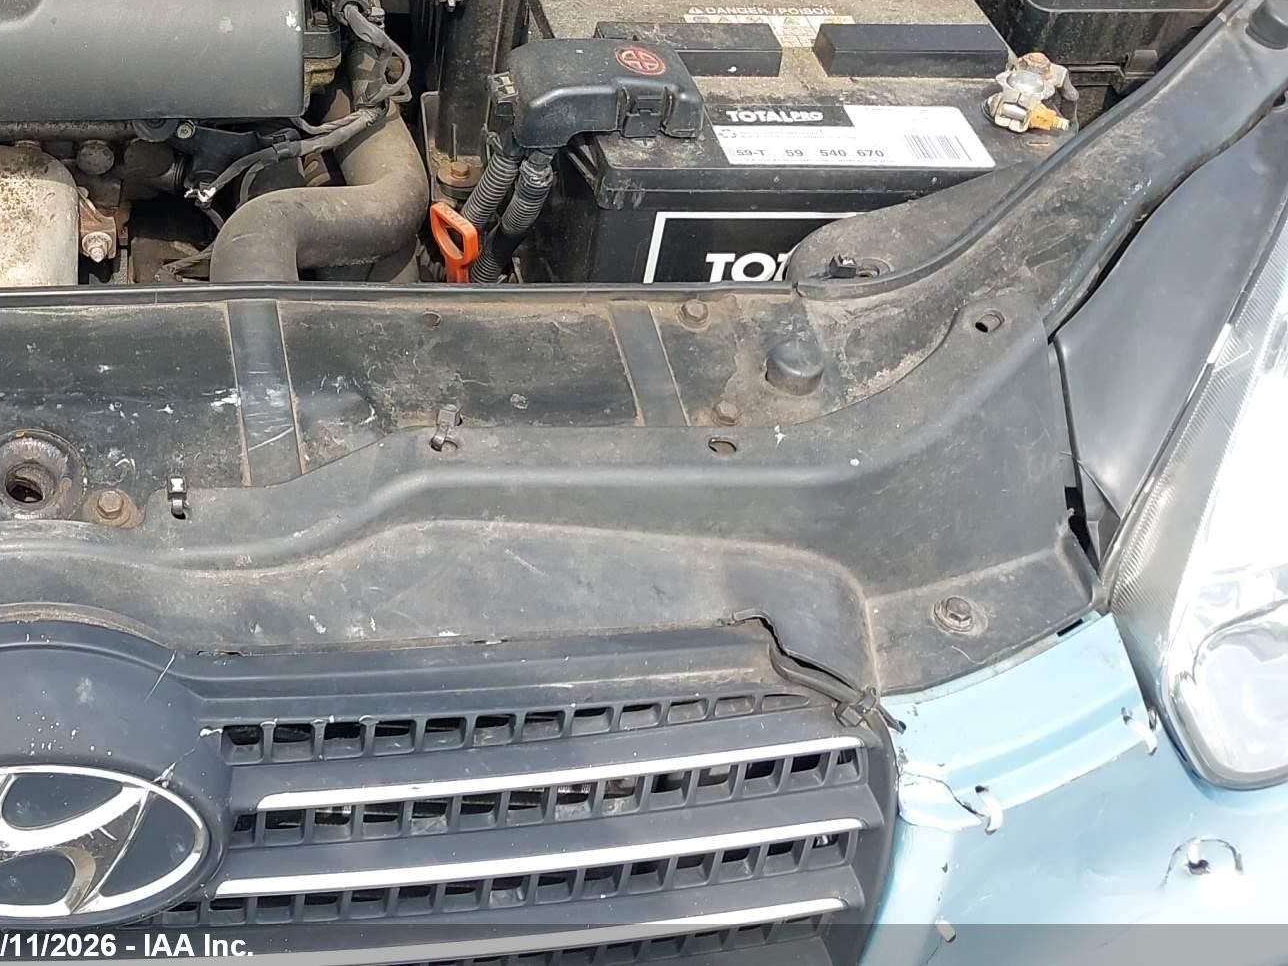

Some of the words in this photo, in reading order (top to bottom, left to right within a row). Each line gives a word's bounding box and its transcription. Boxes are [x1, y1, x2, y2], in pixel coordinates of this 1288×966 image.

[785, 149, 804, 158] 59
[819, 149, 847, 158] 540
[857, 149, 885, 158] 670
